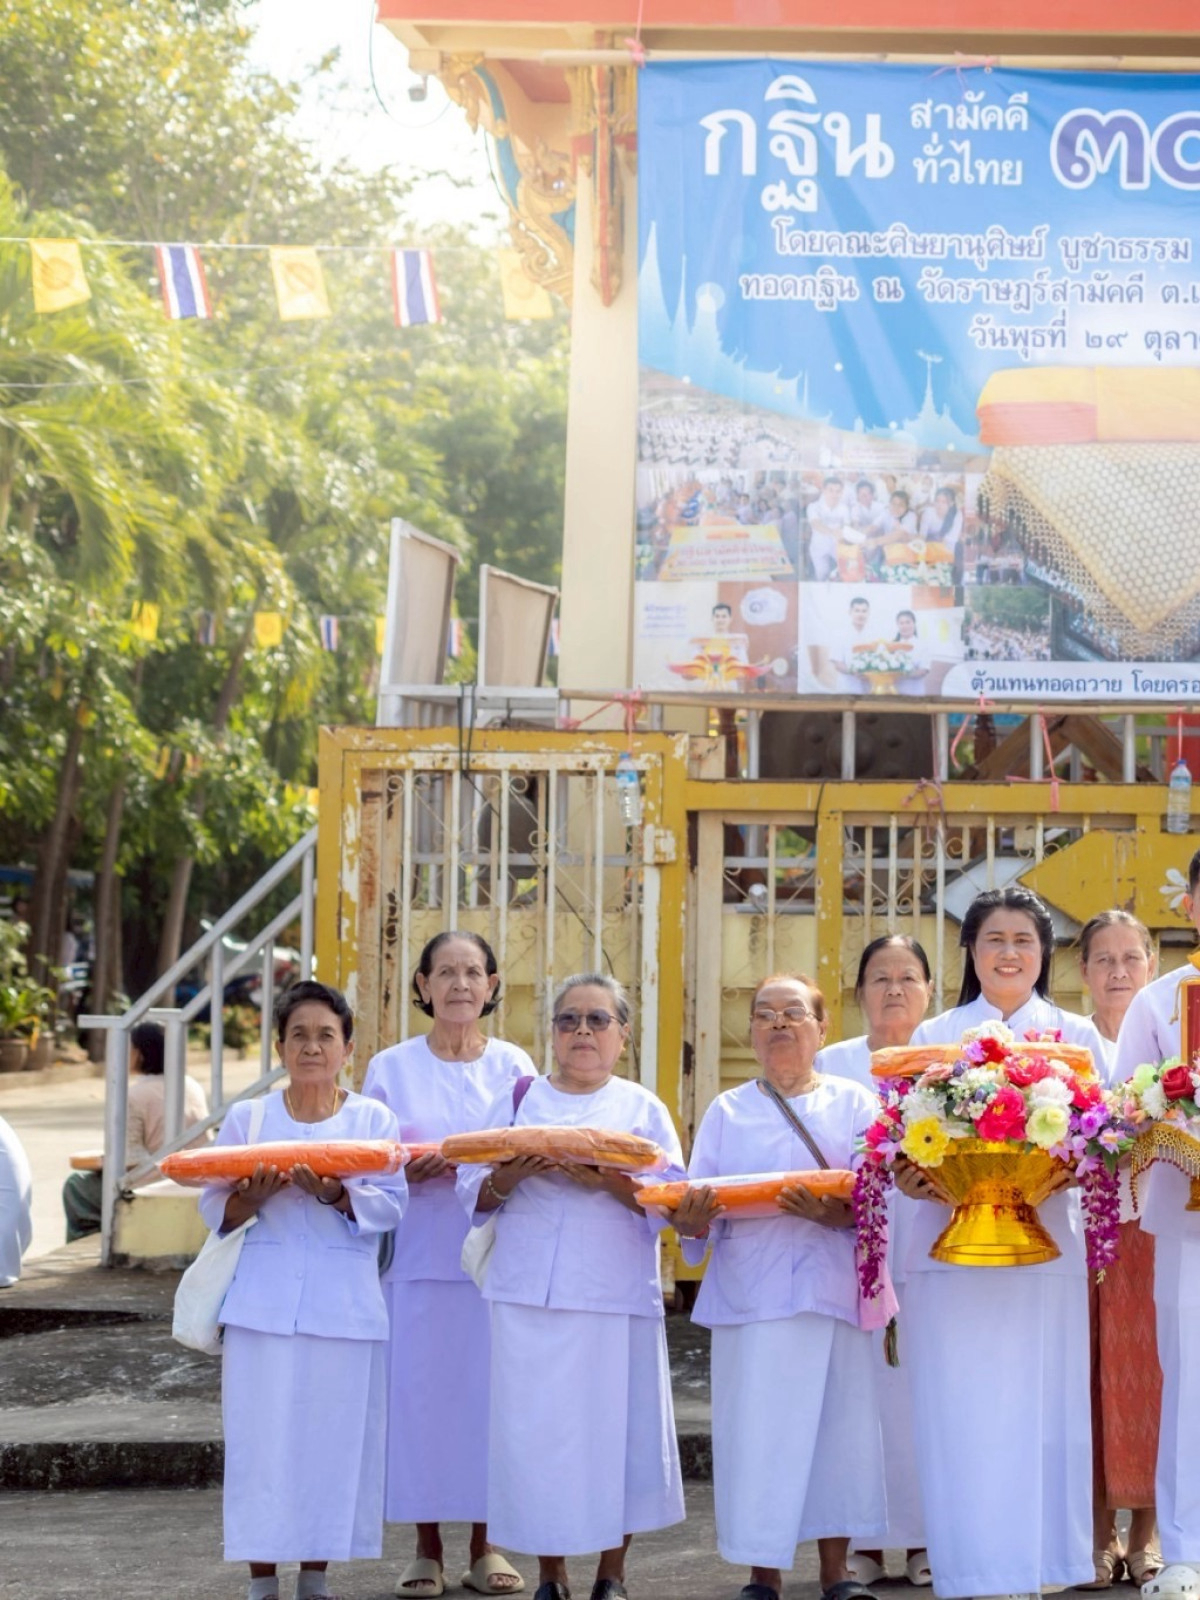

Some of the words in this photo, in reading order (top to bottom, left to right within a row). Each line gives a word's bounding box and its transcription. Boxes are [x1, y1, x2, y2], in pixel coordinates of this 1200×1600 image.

[909, 90, 1030, 132] สามัคคี
[699, 74, 895, 213] กฐิน
[912, 133, 1024, 186] ทั่วไทย
[772, 217, 1049, 270] โดยคณะศิษยานุศิษย์
[1060, 231, 1190, 271] บูชาธรรม
[741, 265, 858, 311] ทอดกฐิน
[873, 277, 903, 301] ณ
[918, 267, 1145, 311] วัดราษฎร์สามัคคี
[969, 309, 1068, 360] วันพุธที่
[1084, 328, 1129, 349] ๒๙
[971, 670, 1123, 694] ตัวแทนทอดถวาย
